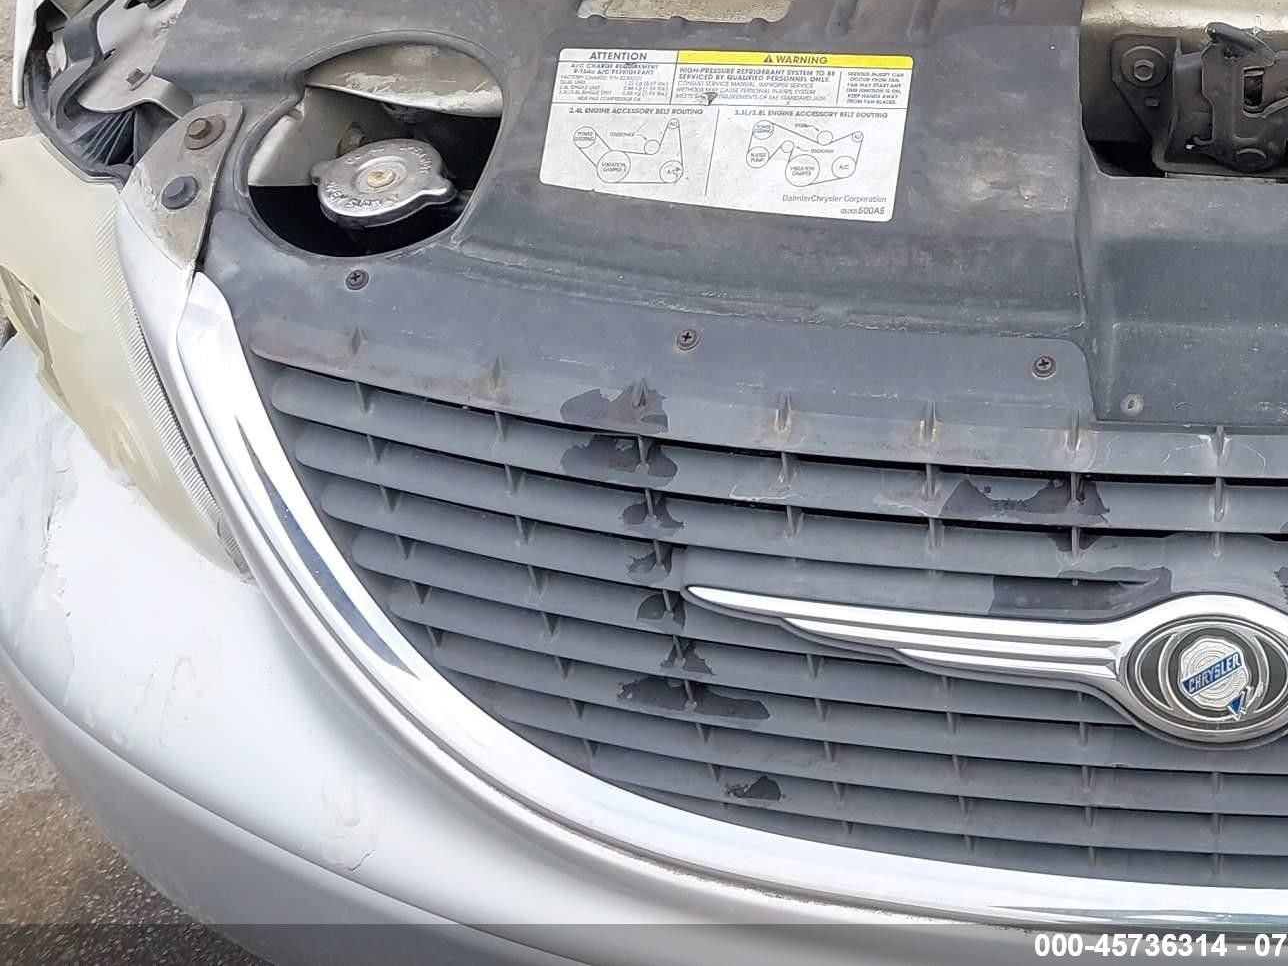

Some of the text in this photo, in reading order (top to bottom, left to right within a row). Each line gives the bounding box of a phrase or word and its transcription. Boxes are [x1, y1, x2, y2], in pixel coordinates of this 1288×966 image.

[589, 51, 647, 61] ATTENTION
[776, 55, 828, 64] WARNING
[679, 67, 735, 75] HIGH-PRESSURE
[794, 110, 839, 118] ACCESSORY
[782, 194, 887, 204] DaimlerChrysler Corporation
[1188, 652, 1241, 692] CHRYSLER
